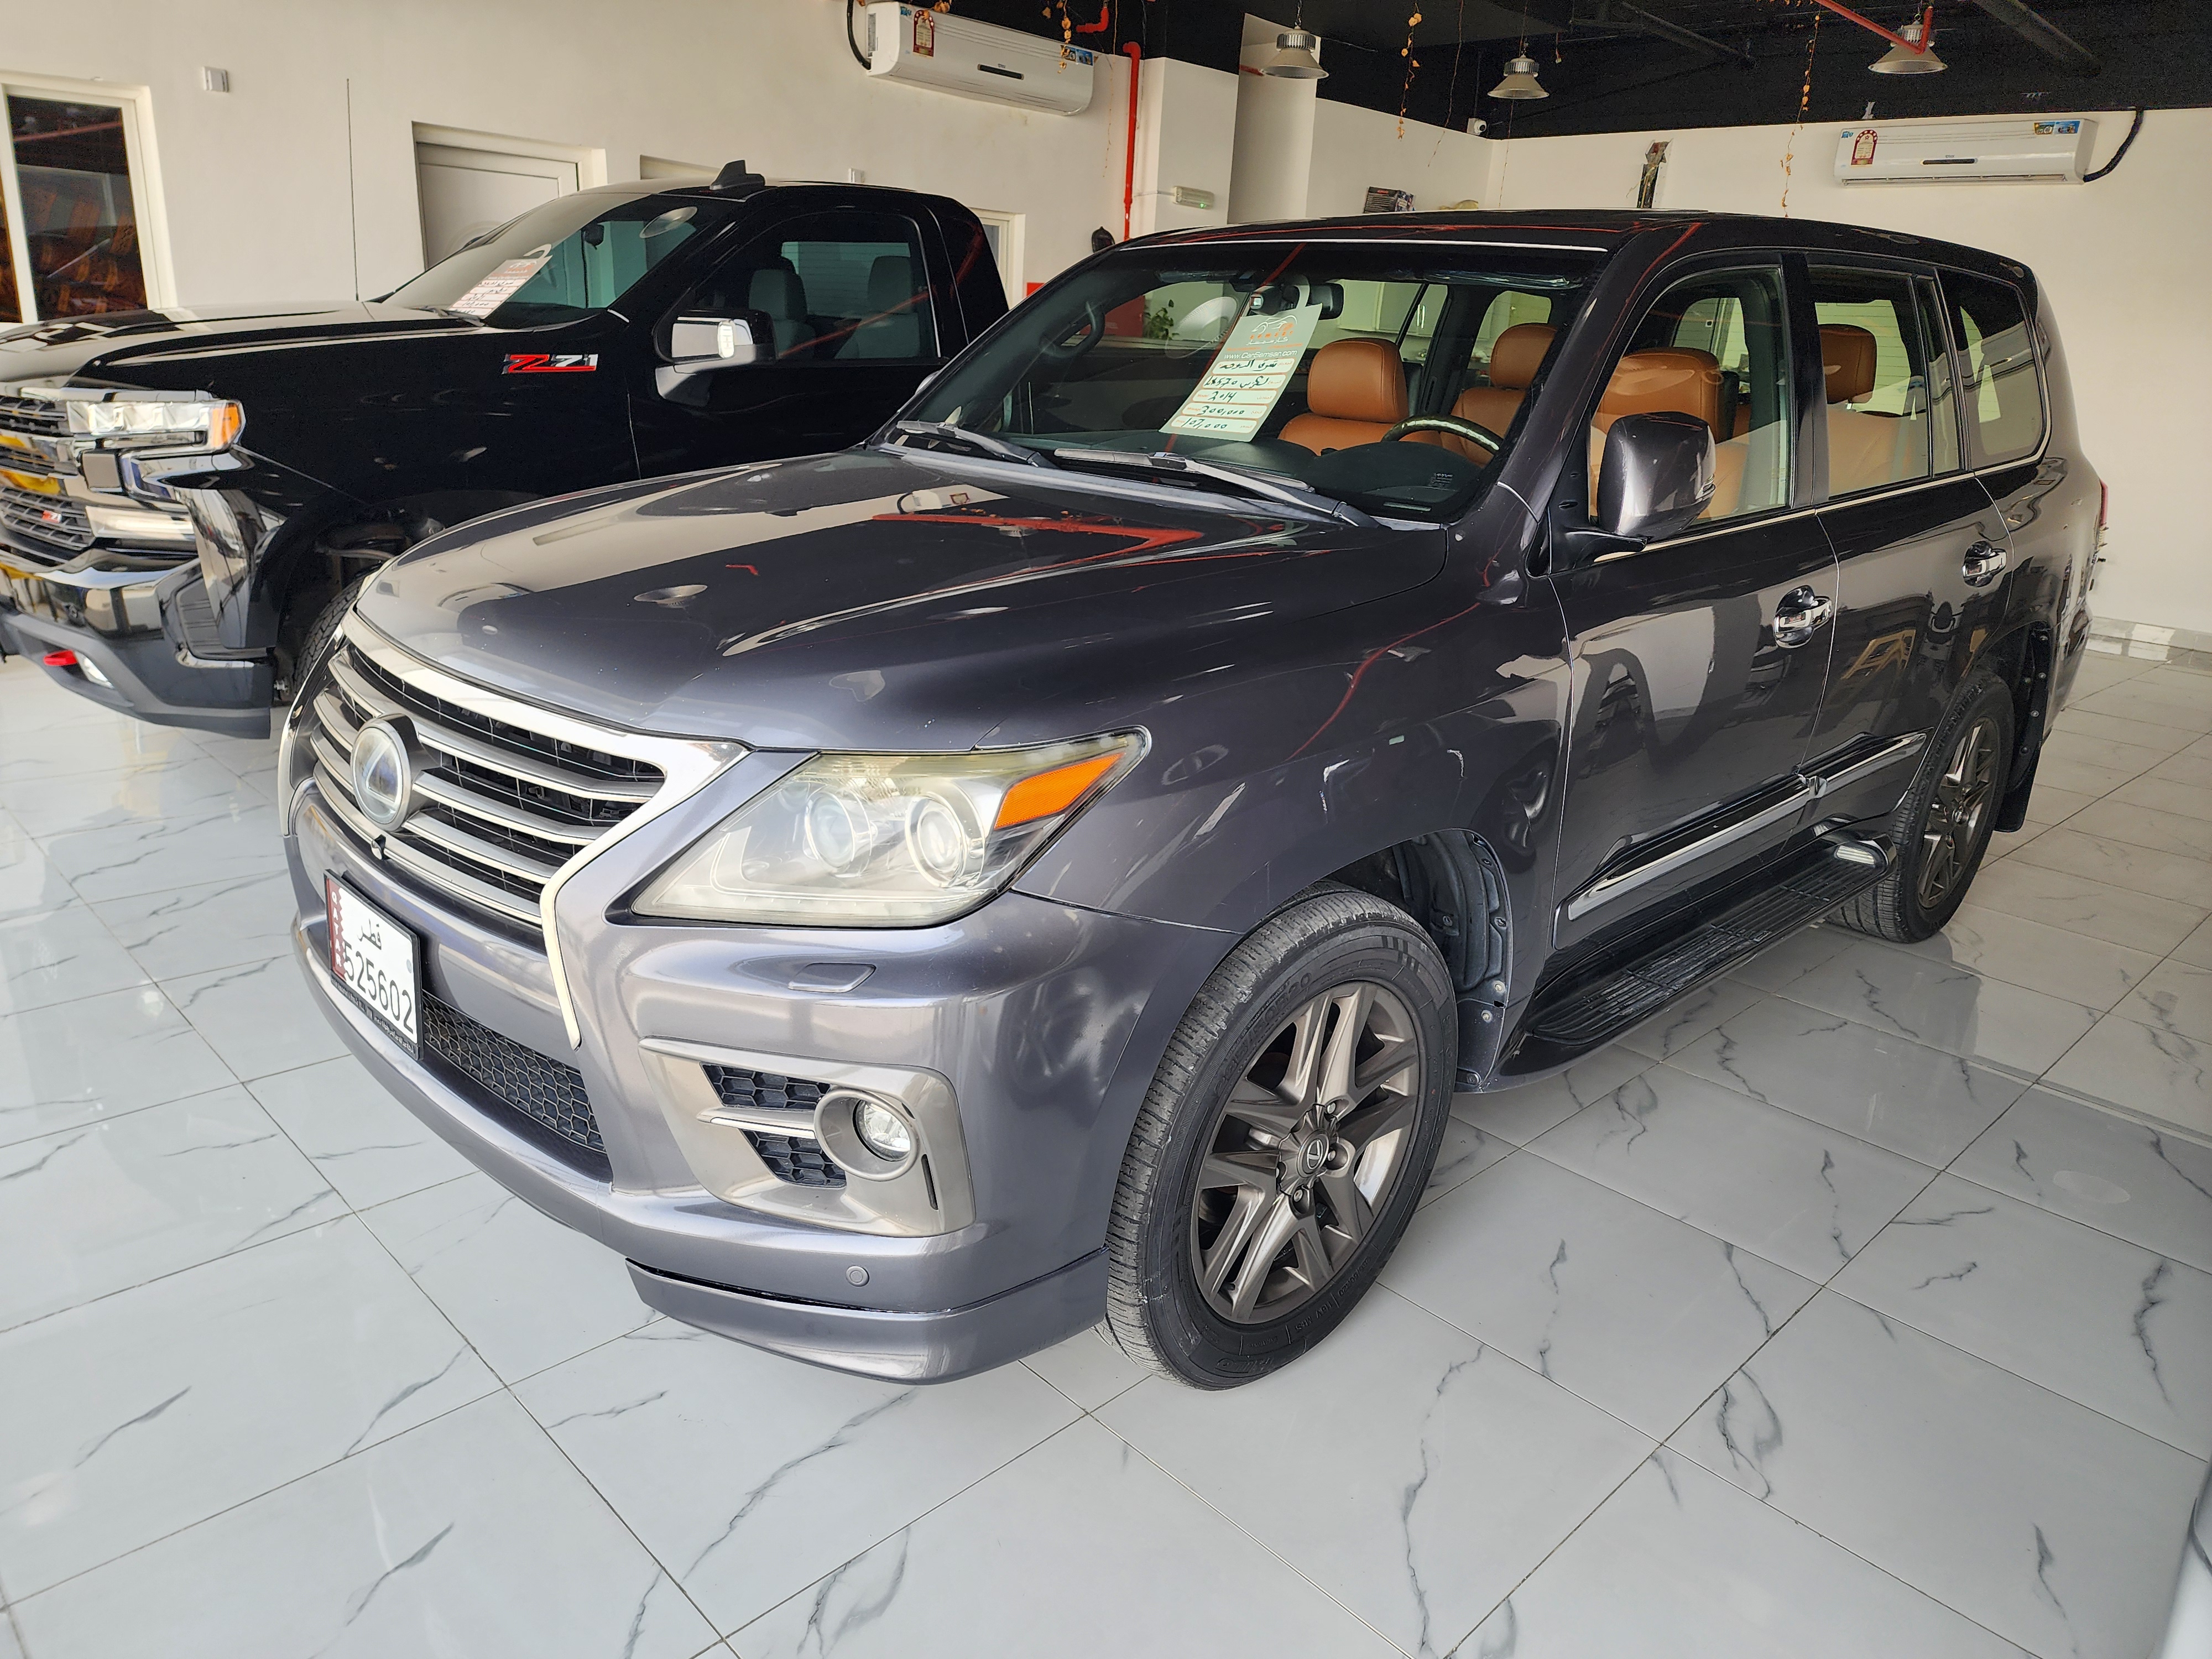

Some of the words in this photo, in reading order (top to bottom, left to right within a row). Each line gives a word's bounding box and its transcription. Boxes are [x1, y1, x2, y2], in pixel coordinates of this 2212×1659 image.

[502, 353, 598, 374] Z71
[1207, 390, 1238, 403] 2014
[1197, 405, 1245, 416] 300,000
[1181, 417, 1228, 430] 107,000
[332, 890, 342, 967] QATAR
[357, 918, 382, 950] قطر
[344, 942, 414, 1035] 525602
